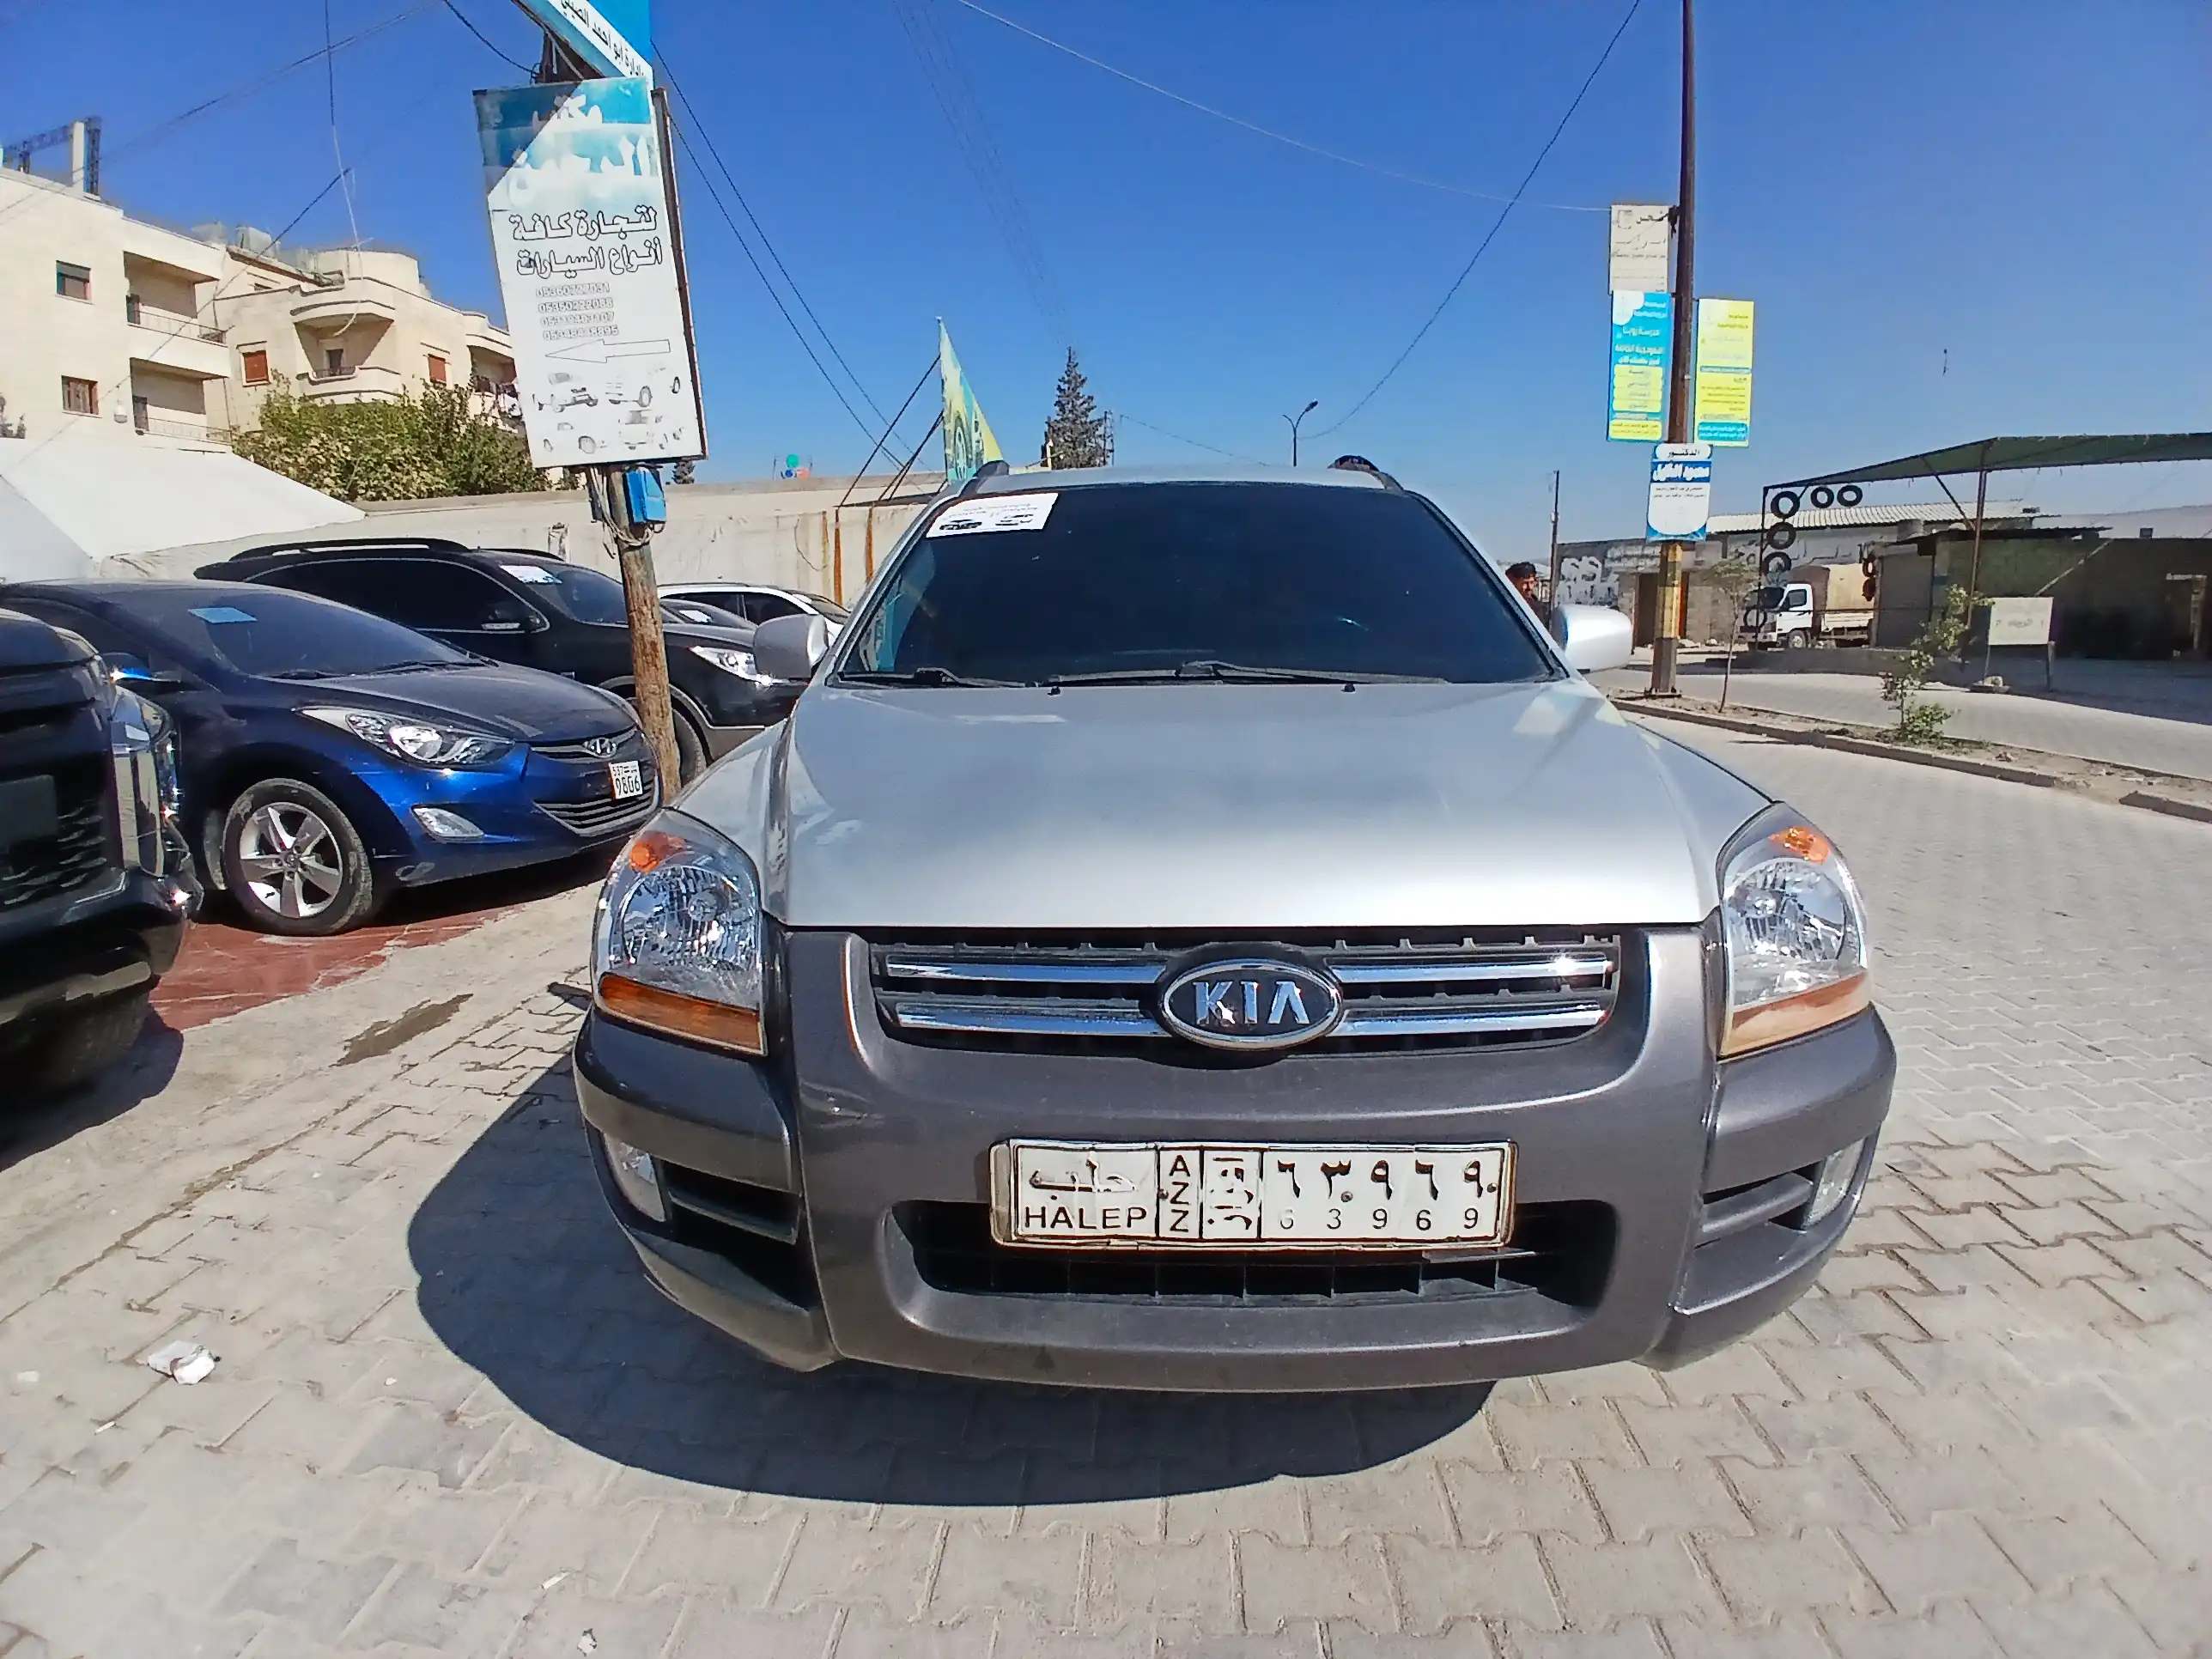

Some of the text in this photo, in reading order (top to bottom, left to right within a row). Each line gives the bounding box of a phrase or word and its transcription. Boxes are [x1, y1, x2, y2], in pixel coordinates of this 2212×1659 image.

[508, 204, 658, 241] لتجارة كافة
[516, 246, 605, 279] السيارات
[615, 775, 641, 796] 9806
[1193, 981, 1310, 1026] KIA
[1024, 1206, 1147, 1229] HALEP
[1279, 1207, 1479, 1231] 63969
